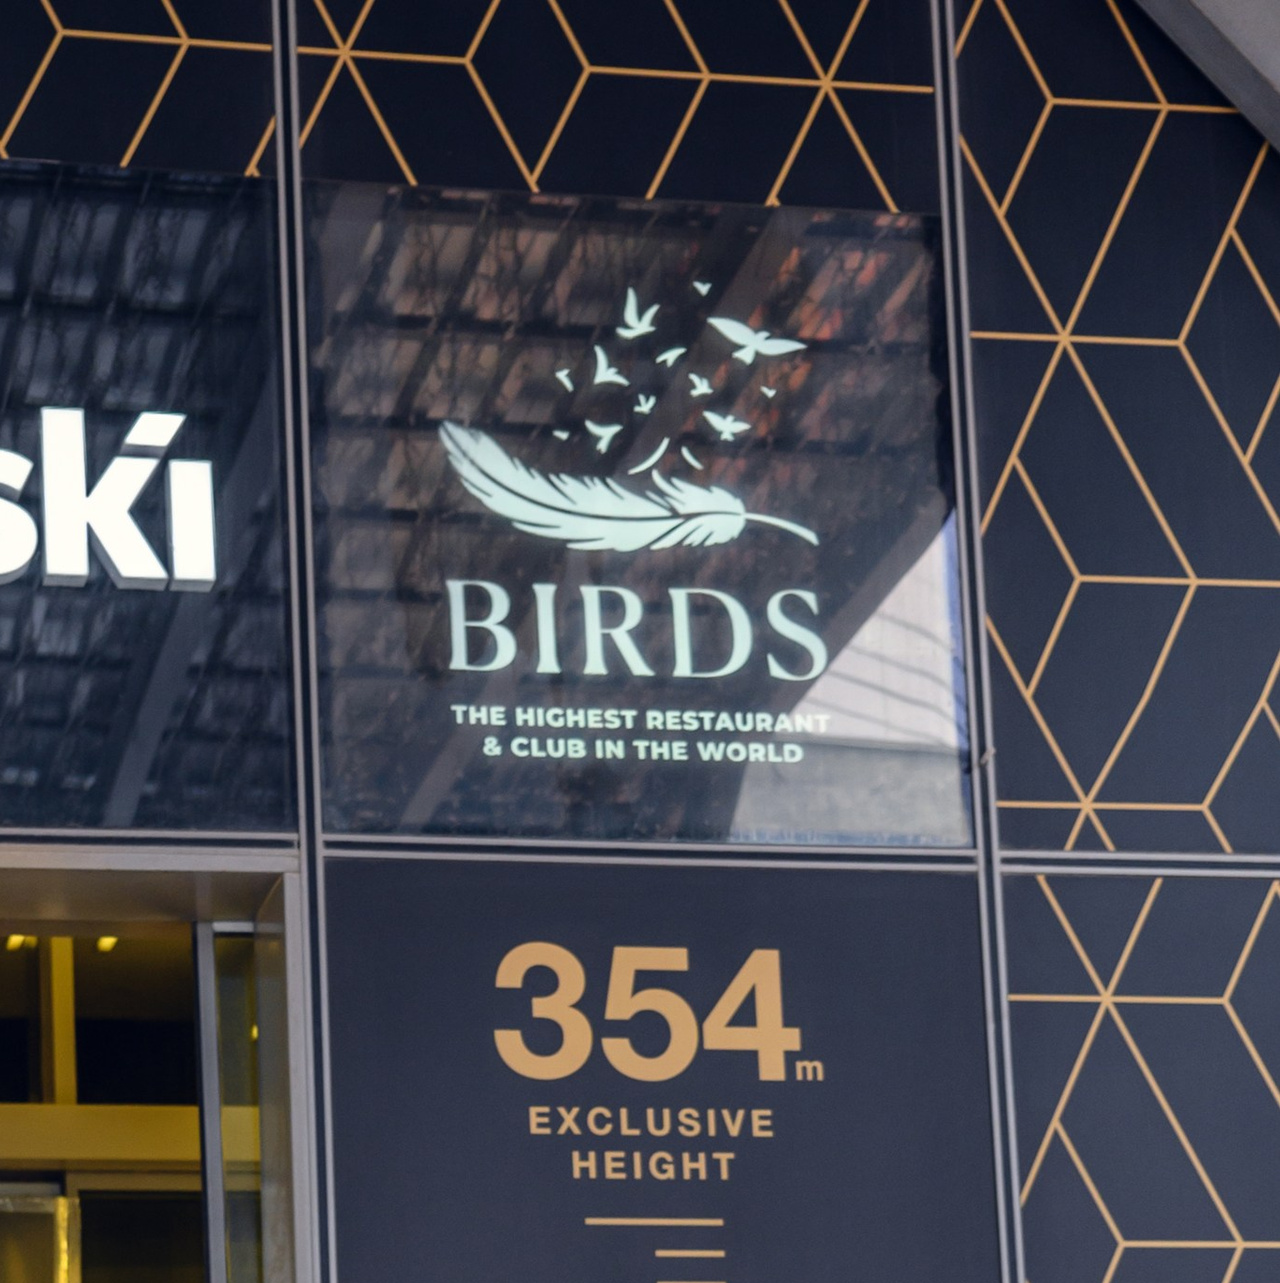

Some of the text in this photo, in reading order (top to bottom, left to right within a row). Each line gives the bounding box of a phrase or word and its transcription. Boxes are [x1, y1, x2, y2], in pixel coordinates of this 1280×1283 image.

[445, 579, 829, 681] BIRDS
[450, 704, 832, 734] THE HIGHEST RESTAURANT
[482, 736, 804, 764] & CLUB IN THE WORLD
[528, 1105, 775, 1138] EXCLUSIVE
[571, 1149, 736, 1181] HEIGHT
